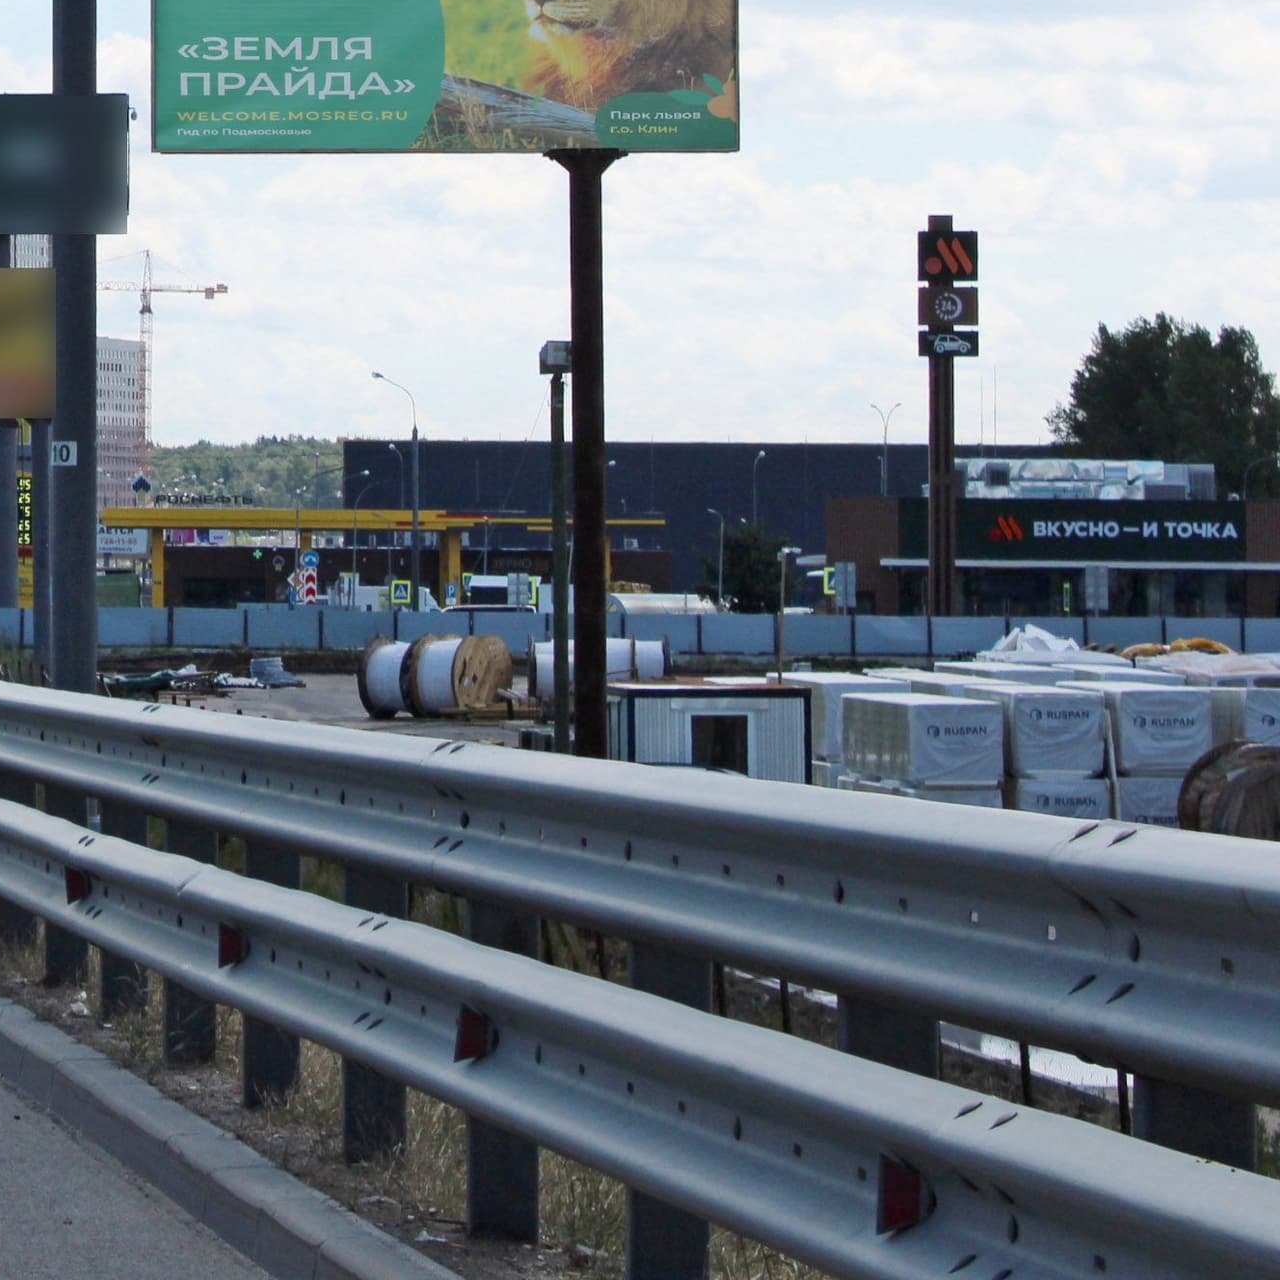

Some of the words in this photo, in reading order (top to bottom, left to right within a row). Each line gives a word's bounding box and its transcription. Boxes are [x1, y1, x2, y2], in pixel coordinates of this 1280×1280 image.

[177, 36, 373, 61] «ЗЕМЛЯ
[179, 66, 416, 100] ПРАЙДА»
[177, 111, 409, 122] WELCOME.MOSREG.RU
[610, 111, 651, 121] Парк
[654, 112, 701, 120] львов
[177, 128, 200, 137] Гид
[222, 128, 312, 136] Подмосковью
[638, 124, 678, 134] Клин
[53, 444, 71, 463] 10
[155, 494, 253, 505] РОСНЕФТЬ
[1033, 520, 1120, 538] ВКУСНО
[1143, 522, 1158, 537] И
[1164, 522, 1238, 539] ТОЧКА
[1047, 710, 1090, 720] RUSPAN
[1151, 717, 1195, 727] RUSPAN
[944, 727, 988, 737] RUSPAN
[1054, 796, 1097, 807] RUSPAN
